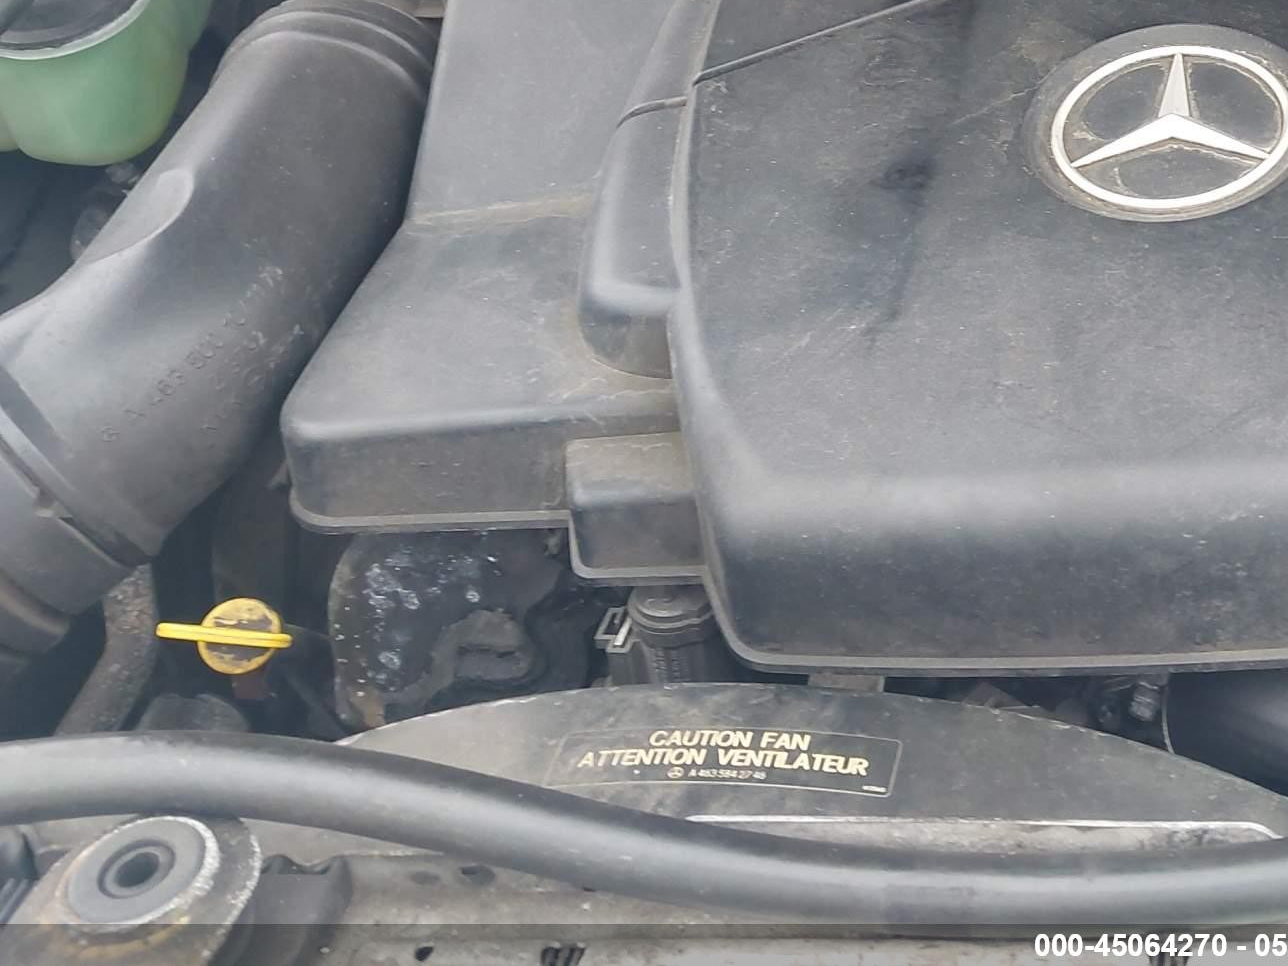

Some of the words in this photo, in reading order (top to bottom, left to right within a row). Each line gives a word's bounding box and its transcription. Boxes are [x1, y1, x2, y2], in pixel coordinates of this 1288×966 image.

[649, 730, 753, 748] CAUTION
[759, 731, 811, 751] FAN
[577, 748, 707, 767] ATTENTION
[718, 748, 869, 776] VENTILATEUR
